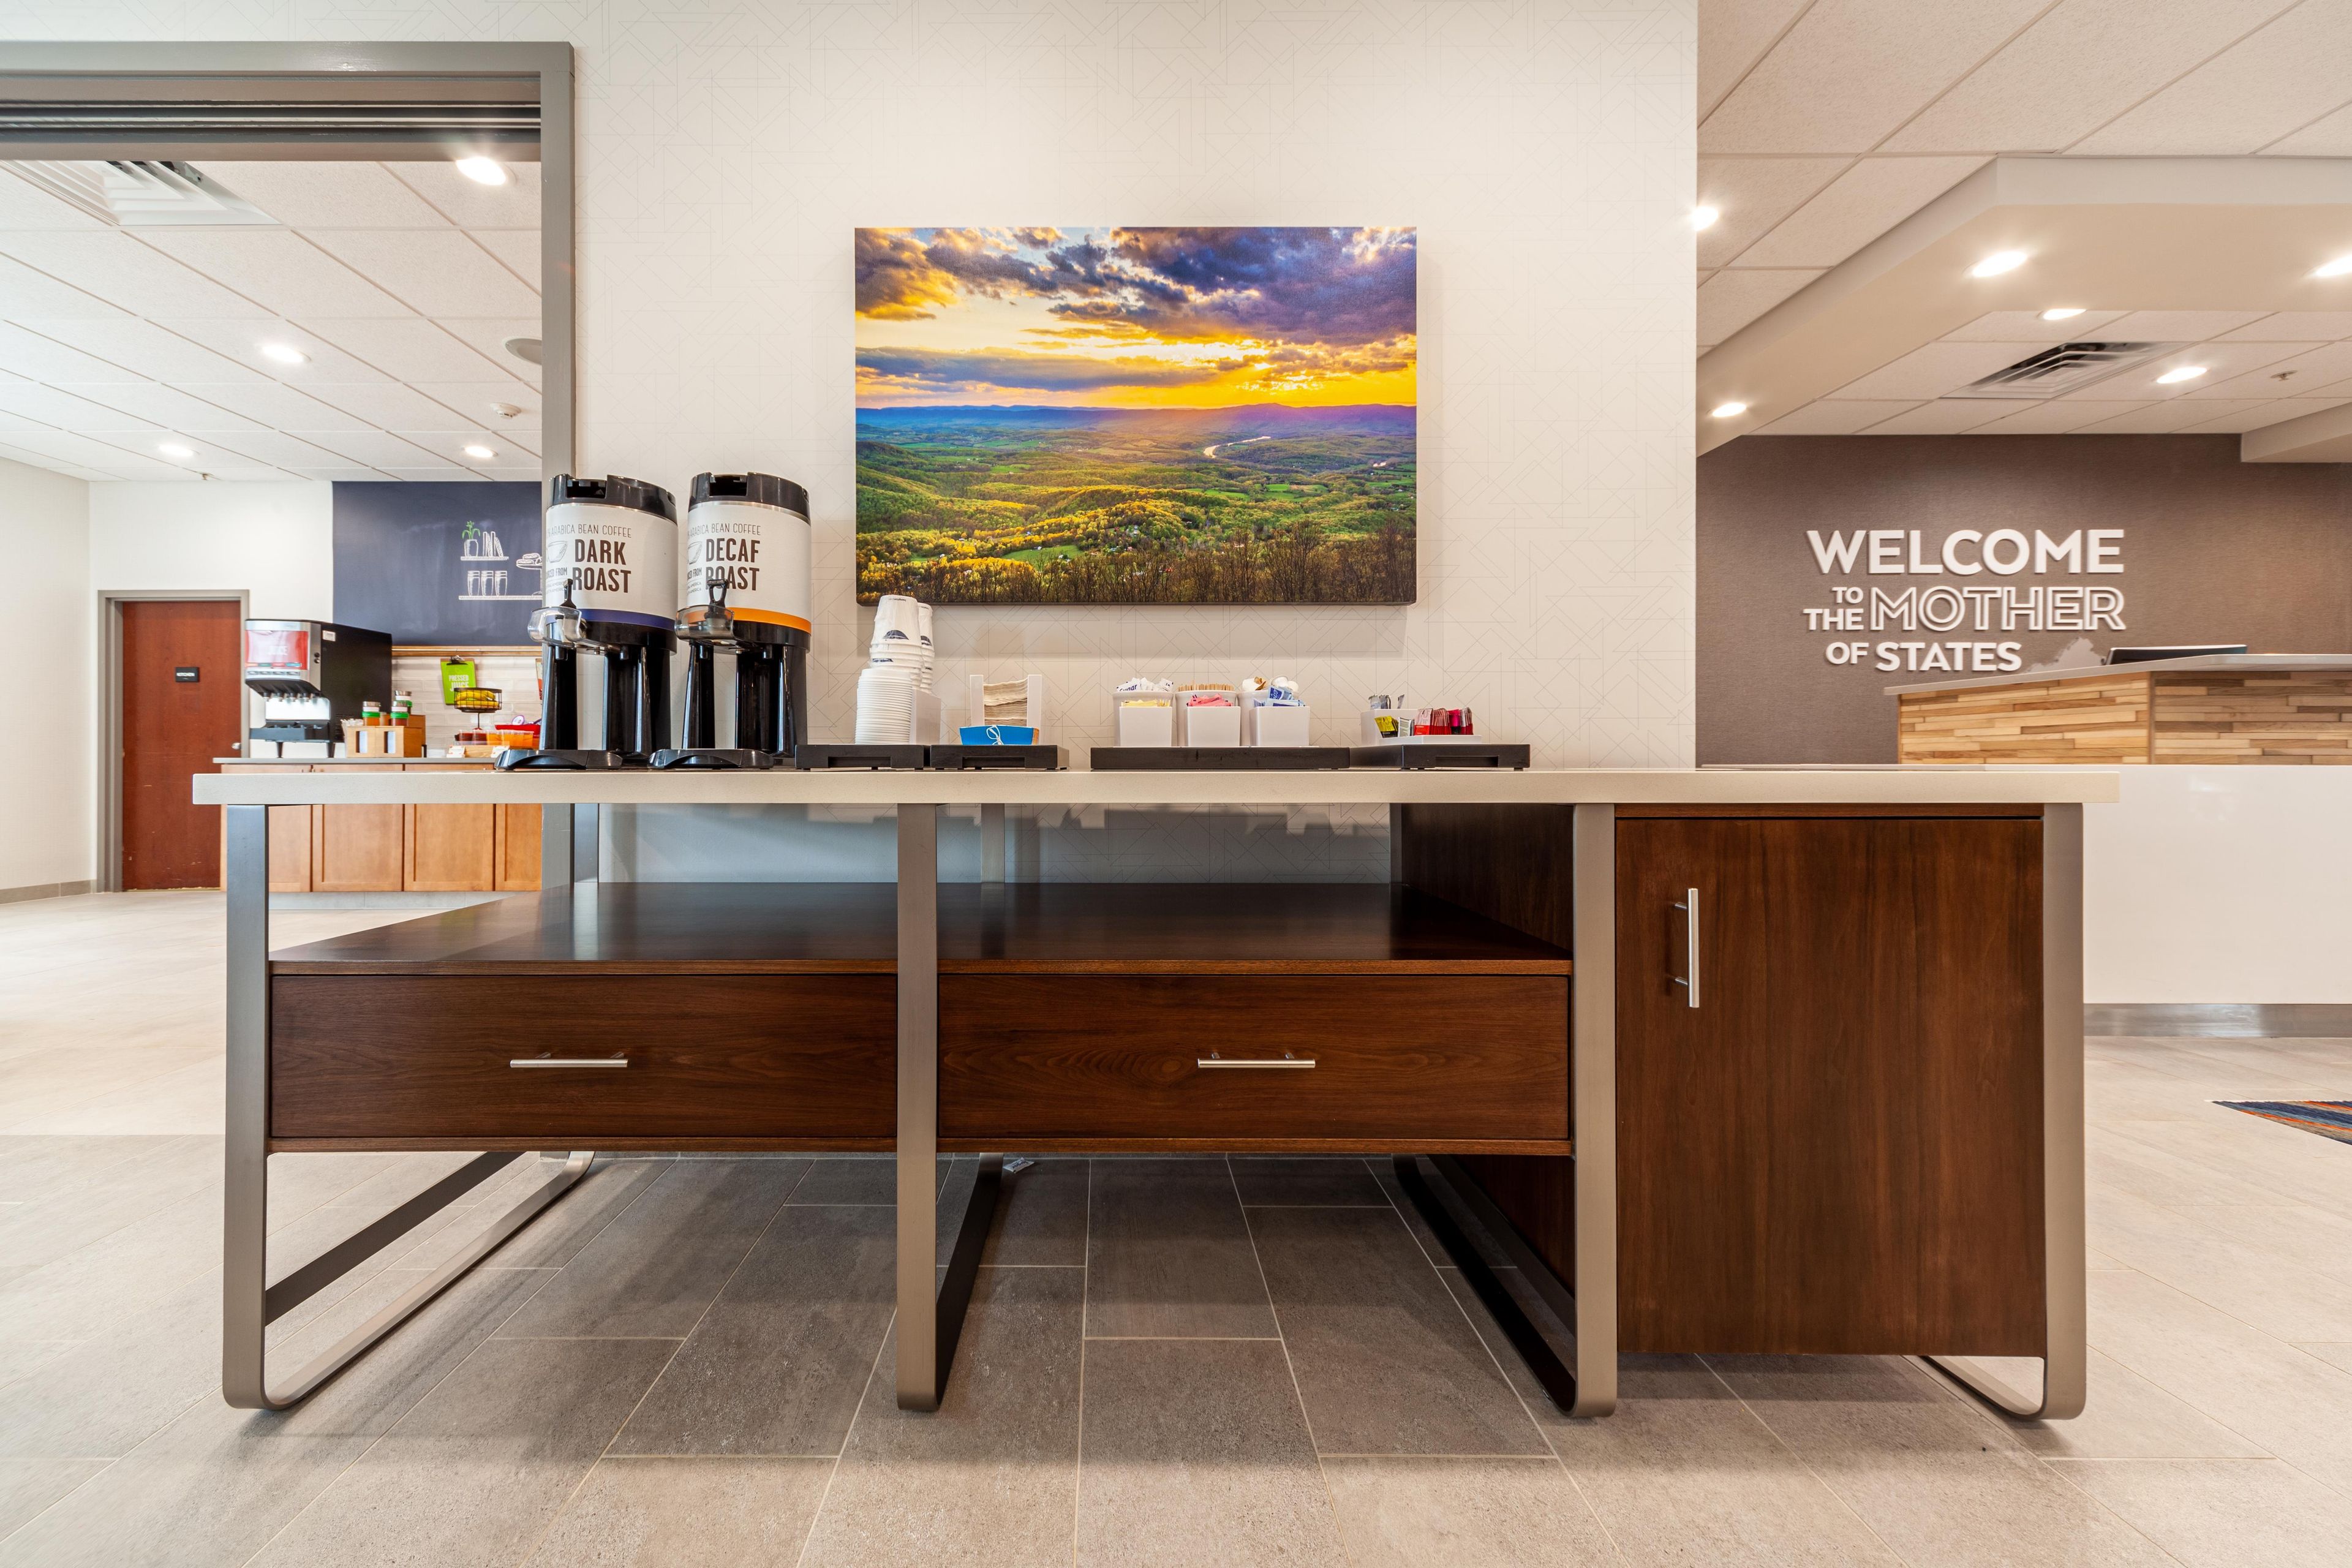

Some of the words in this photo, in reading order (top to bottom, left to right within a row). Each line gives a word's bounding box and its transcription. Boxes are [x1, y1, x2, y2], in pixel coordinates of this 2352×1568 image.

[578, 524, 598, 534] BEAN
[602, 525, 631, 538] COFFEE
[711, 523, 729, 533] BEAN
[733, 523, 761, 535] COFFEE
[575, 539, 626, 565] DARK
[706, 538, 760, 563] DECAF
[1806, 529, 2124, 575] WELCOME
[573, 567, 631, 593] ROAST
[706, 566, 760, 591] ROAST
[1831, 586, 1864, 604] TO
[1803, 608, 1864, 630] THE
[1870, 585, 2127, 631] MOTHER
[1825, 641, 1869, 665] OF
[1875, 641, 2022, 671] STATES
